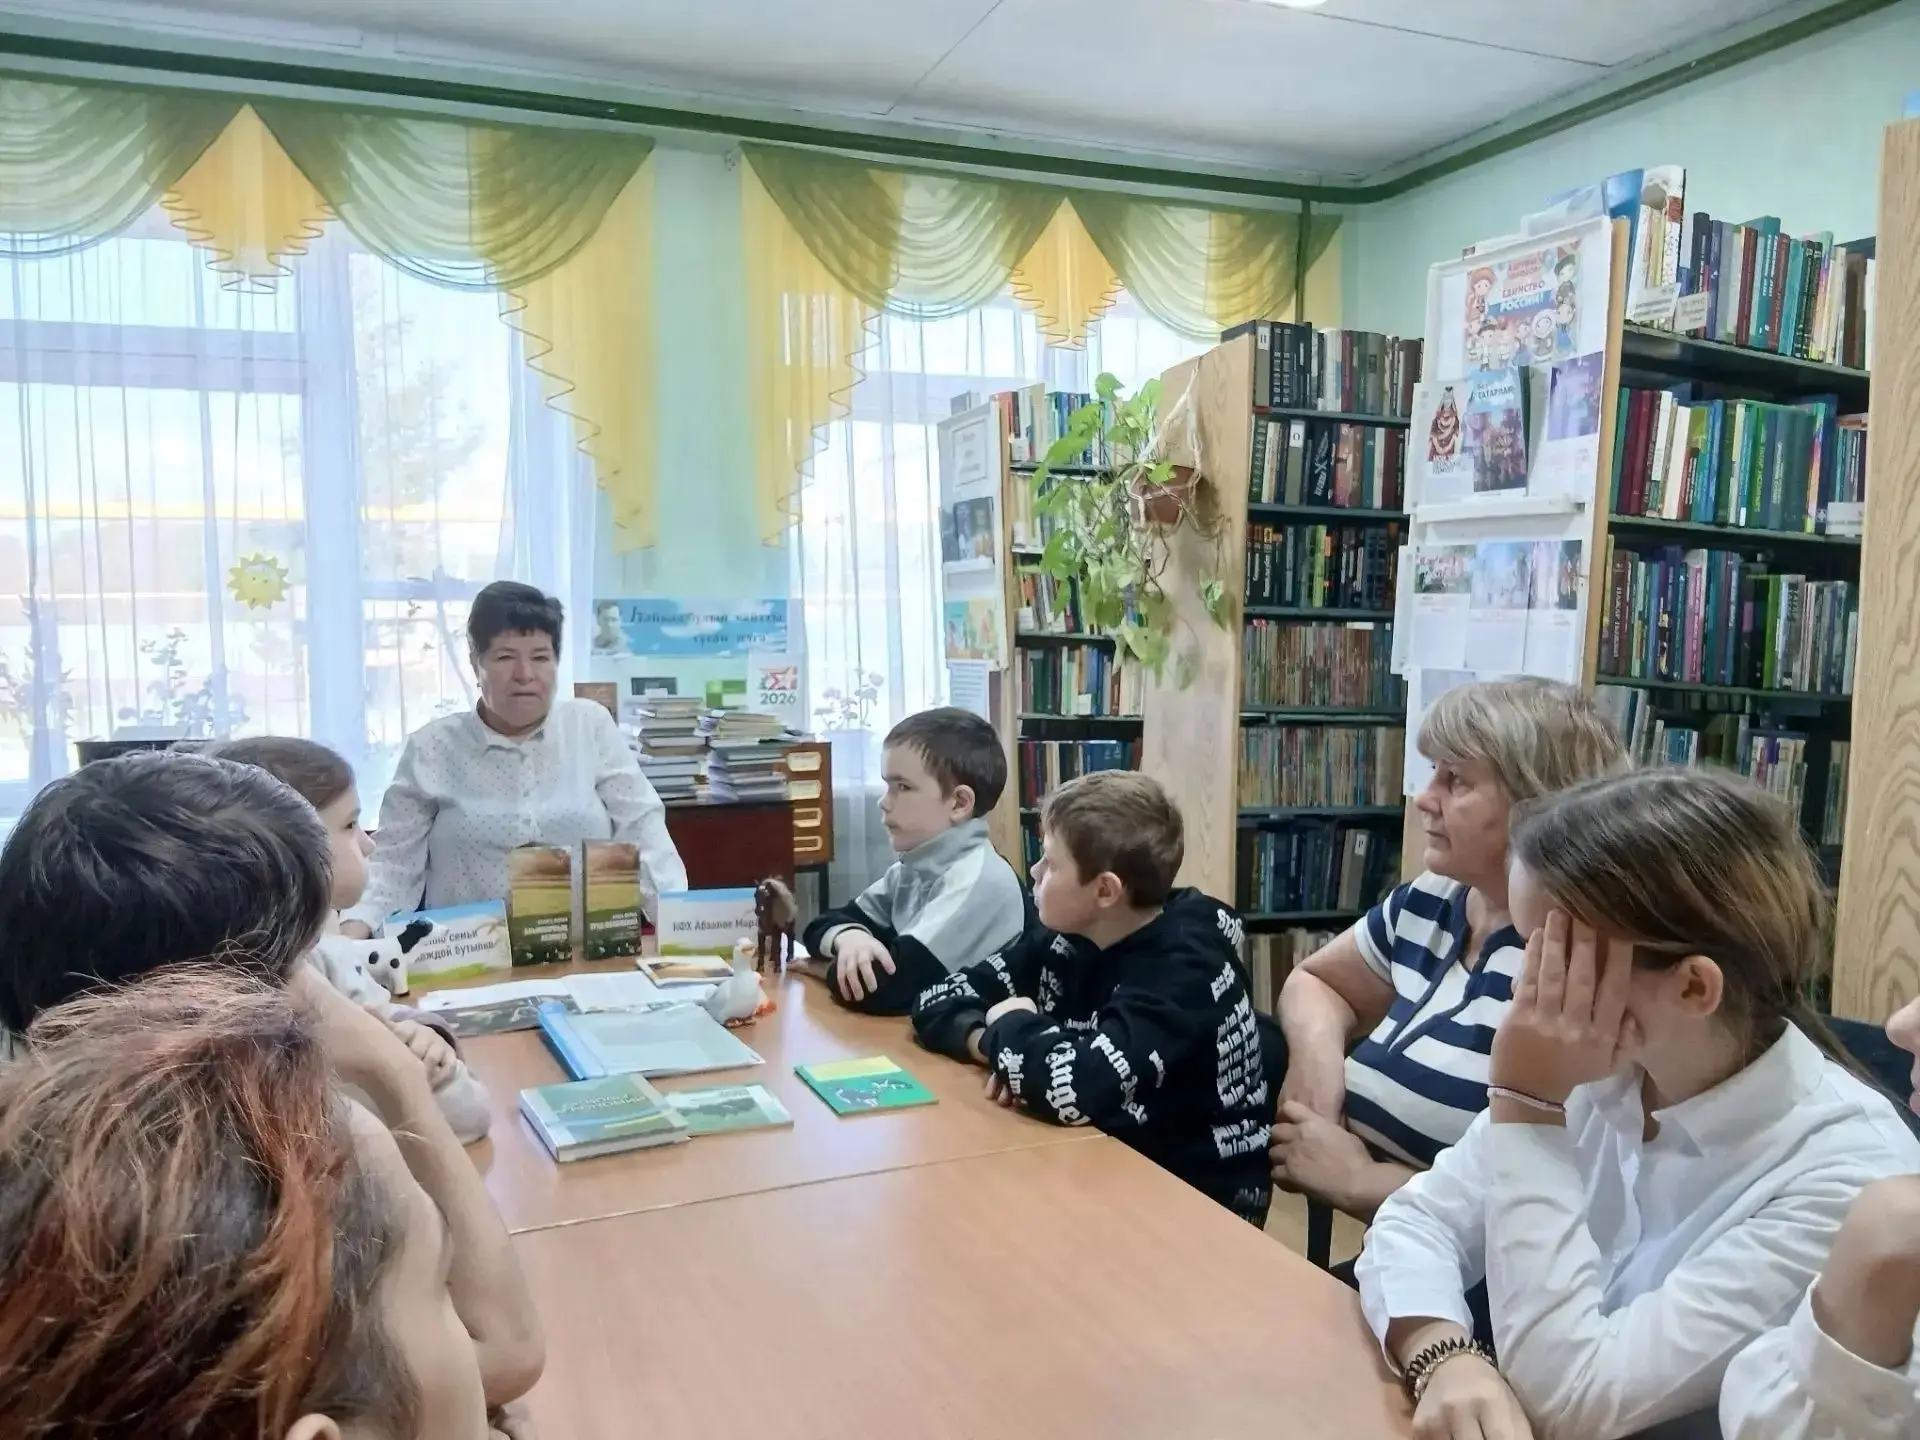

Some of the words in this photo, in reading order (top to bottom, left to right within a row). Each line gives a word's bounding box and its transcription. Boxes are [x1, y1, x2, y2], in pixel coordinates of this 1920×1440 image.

[1502, 280, 1546, 298] ЕДИНСТВО
[760, 692, 797, 706] 2026
[673, 921, 693, 932] КФХ
[449, 930, 479, 943] семьи
